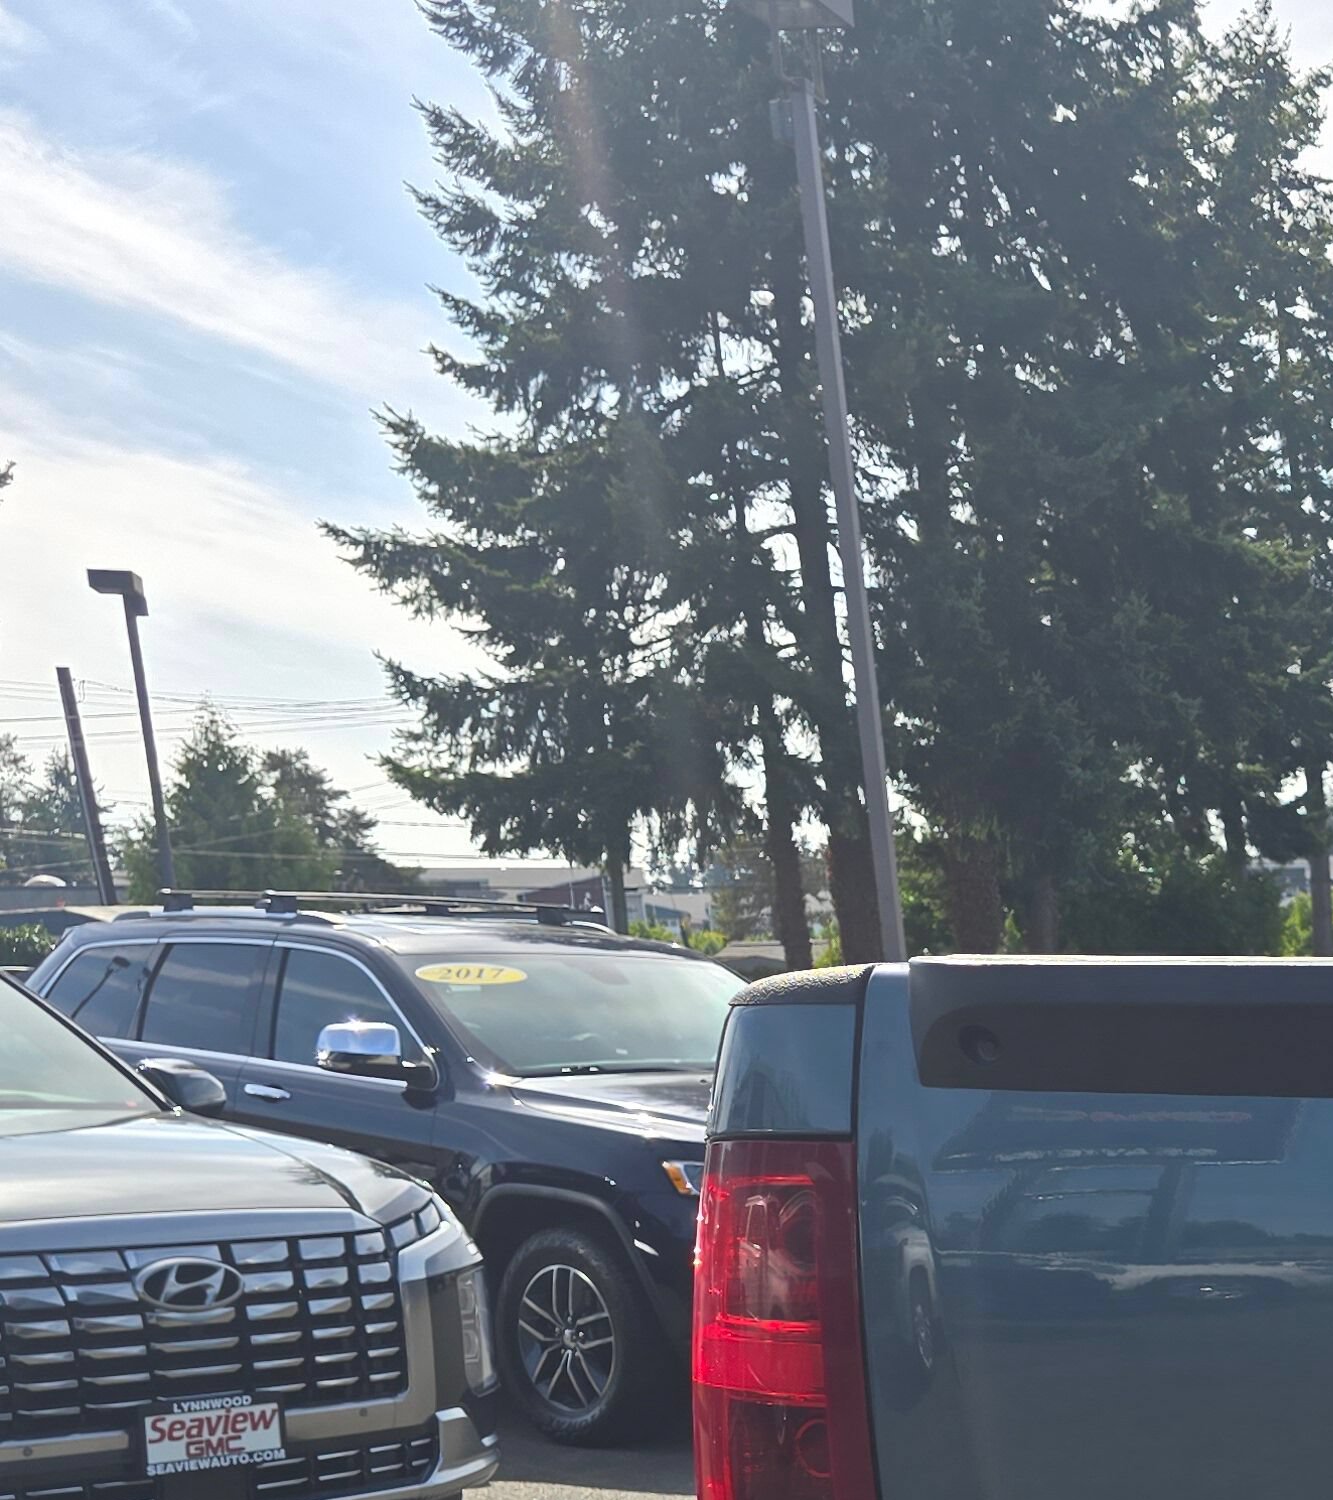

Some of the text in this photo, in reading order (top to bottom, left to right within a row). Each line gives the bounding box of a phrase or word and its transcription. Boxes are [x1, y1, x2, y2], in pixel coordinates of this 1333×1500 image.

[439, 967, 504, 979] 2017
[173, 1395, 252, 1413] LYNNWOOD
[149, 1407, 278, 1444] Seaview
[186, 1435, 245, 1458] GMC
[146, 1449, 286, 1476] SEAVIEWAUTO.COM
